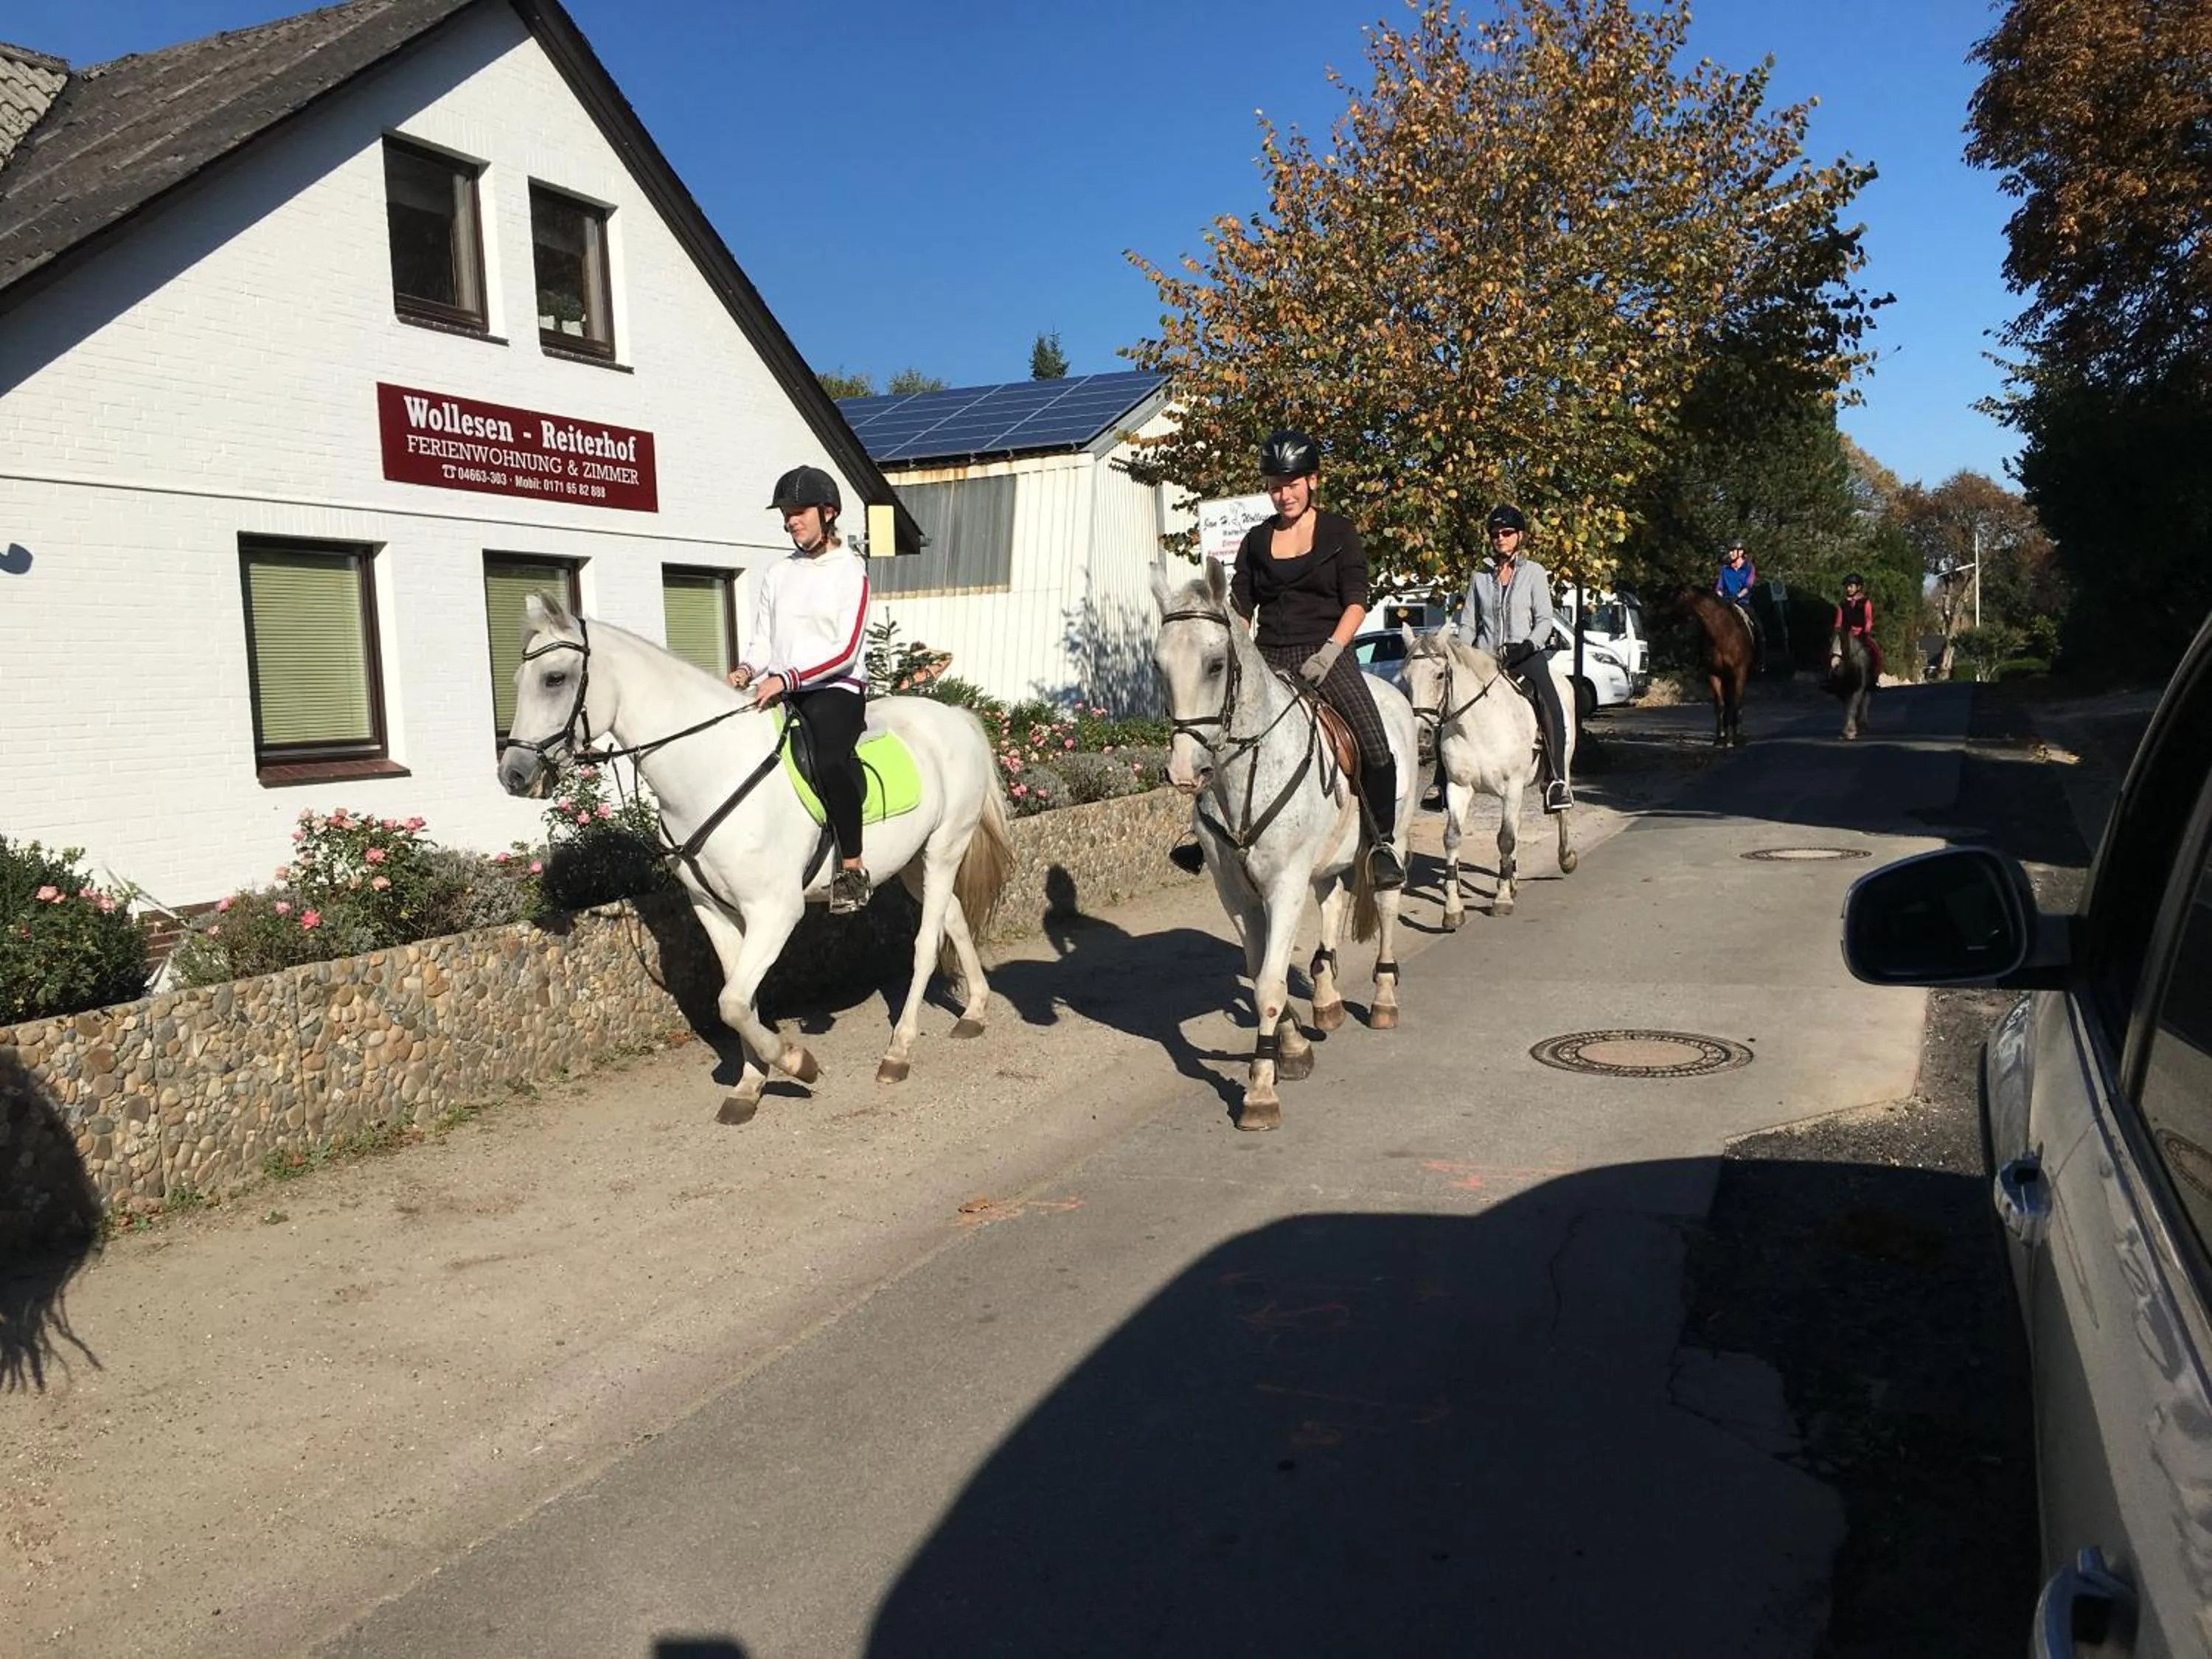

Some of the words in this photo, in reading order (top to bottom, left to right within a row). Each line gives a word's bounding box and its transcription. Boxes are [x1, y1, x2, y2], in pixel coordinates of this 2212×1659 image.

[404, 395, 514, 442] Wollesen
[540, 420, 637, 462] Reiterhof
[406, 434, 563, 473] FERIENWOHNUNG
[568, 460, 579, 476] &
[582, 462, 640, 484] ZIMMER
[515, 474, 543, 490] Mobil:
[543, 479, 564, 493] 0171
